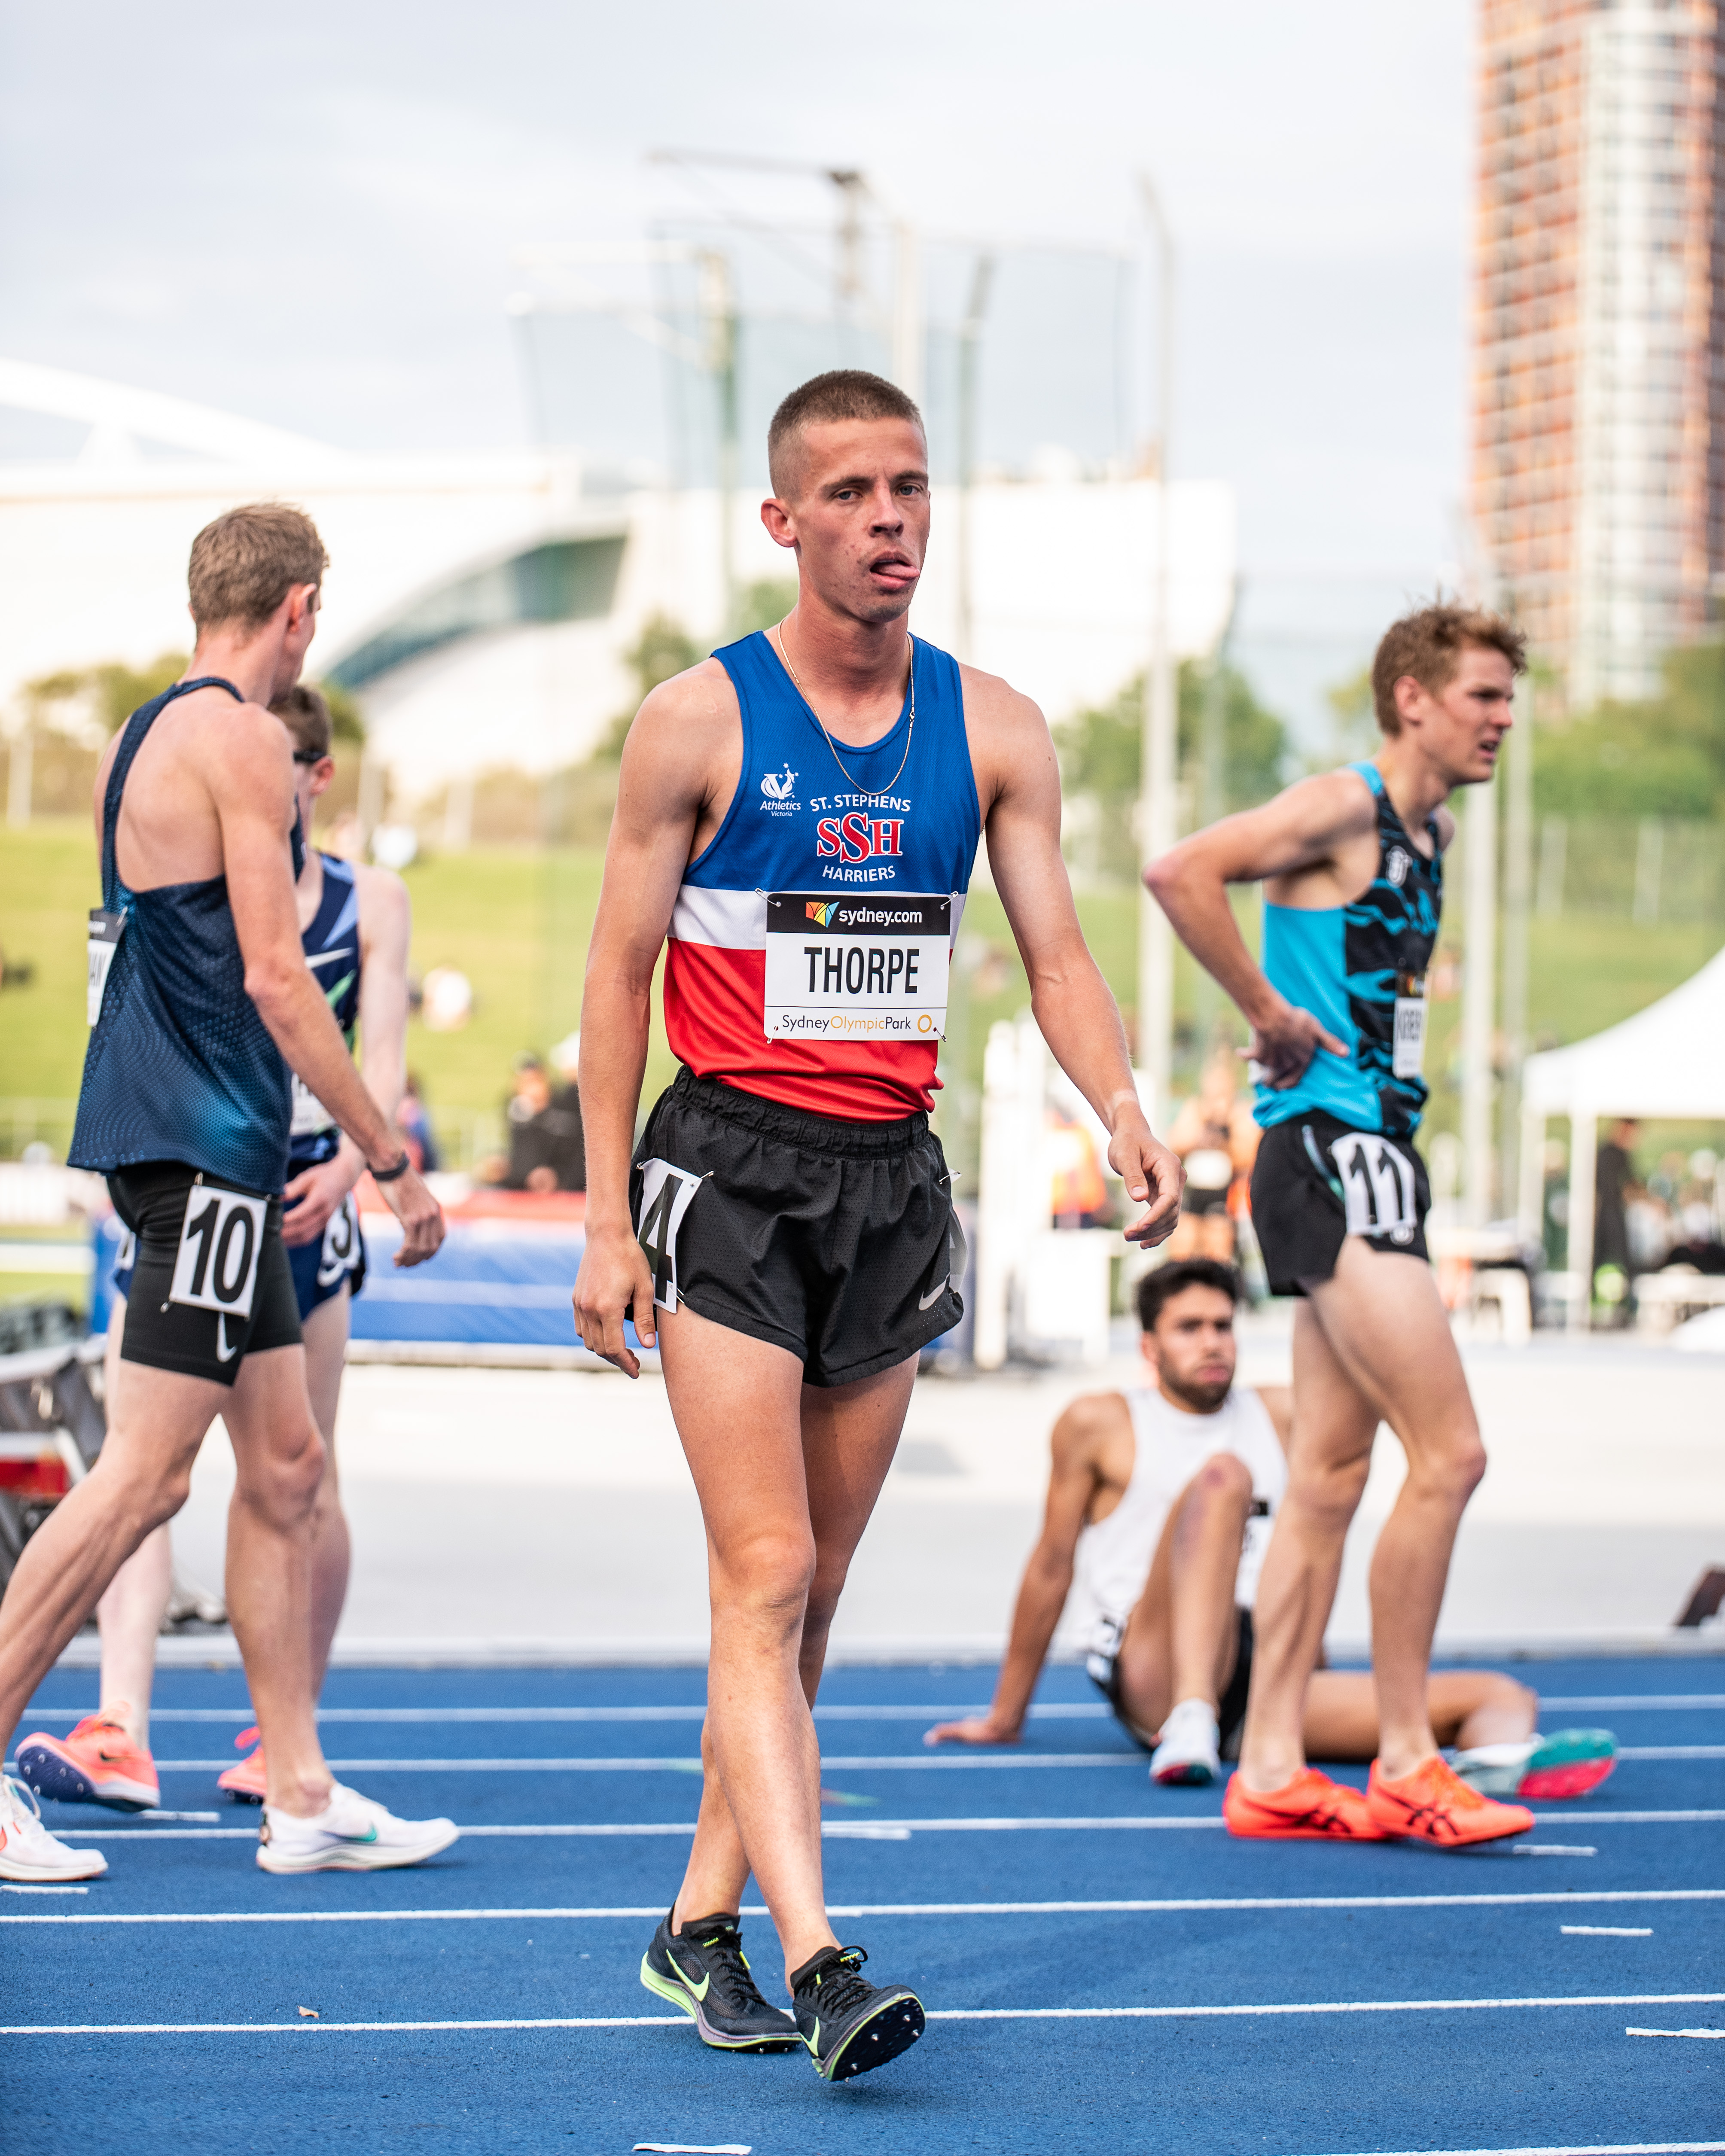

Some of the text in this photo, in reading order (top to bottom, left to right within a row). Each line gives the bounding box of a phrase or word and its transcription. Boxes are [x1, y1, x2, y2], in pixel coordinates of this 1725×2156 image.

[760, 800, 801, 811] Athletics
[810, 794, 911, 811] ST. STEPHENS
[817, 812, 904, 863] SSH
[822, 865, 896, 882] HARRIERS
[838, 907, 922, 926] sydney.com
[804, 947, 920, 994] THORPE
[782, 1014, 911, 1033] SydneyOlympicPark
[1349, 1142, 1404, 1225] 11
[187, 1198, 254, 1303] 10
[639, 1173, 683, 1304] 4
